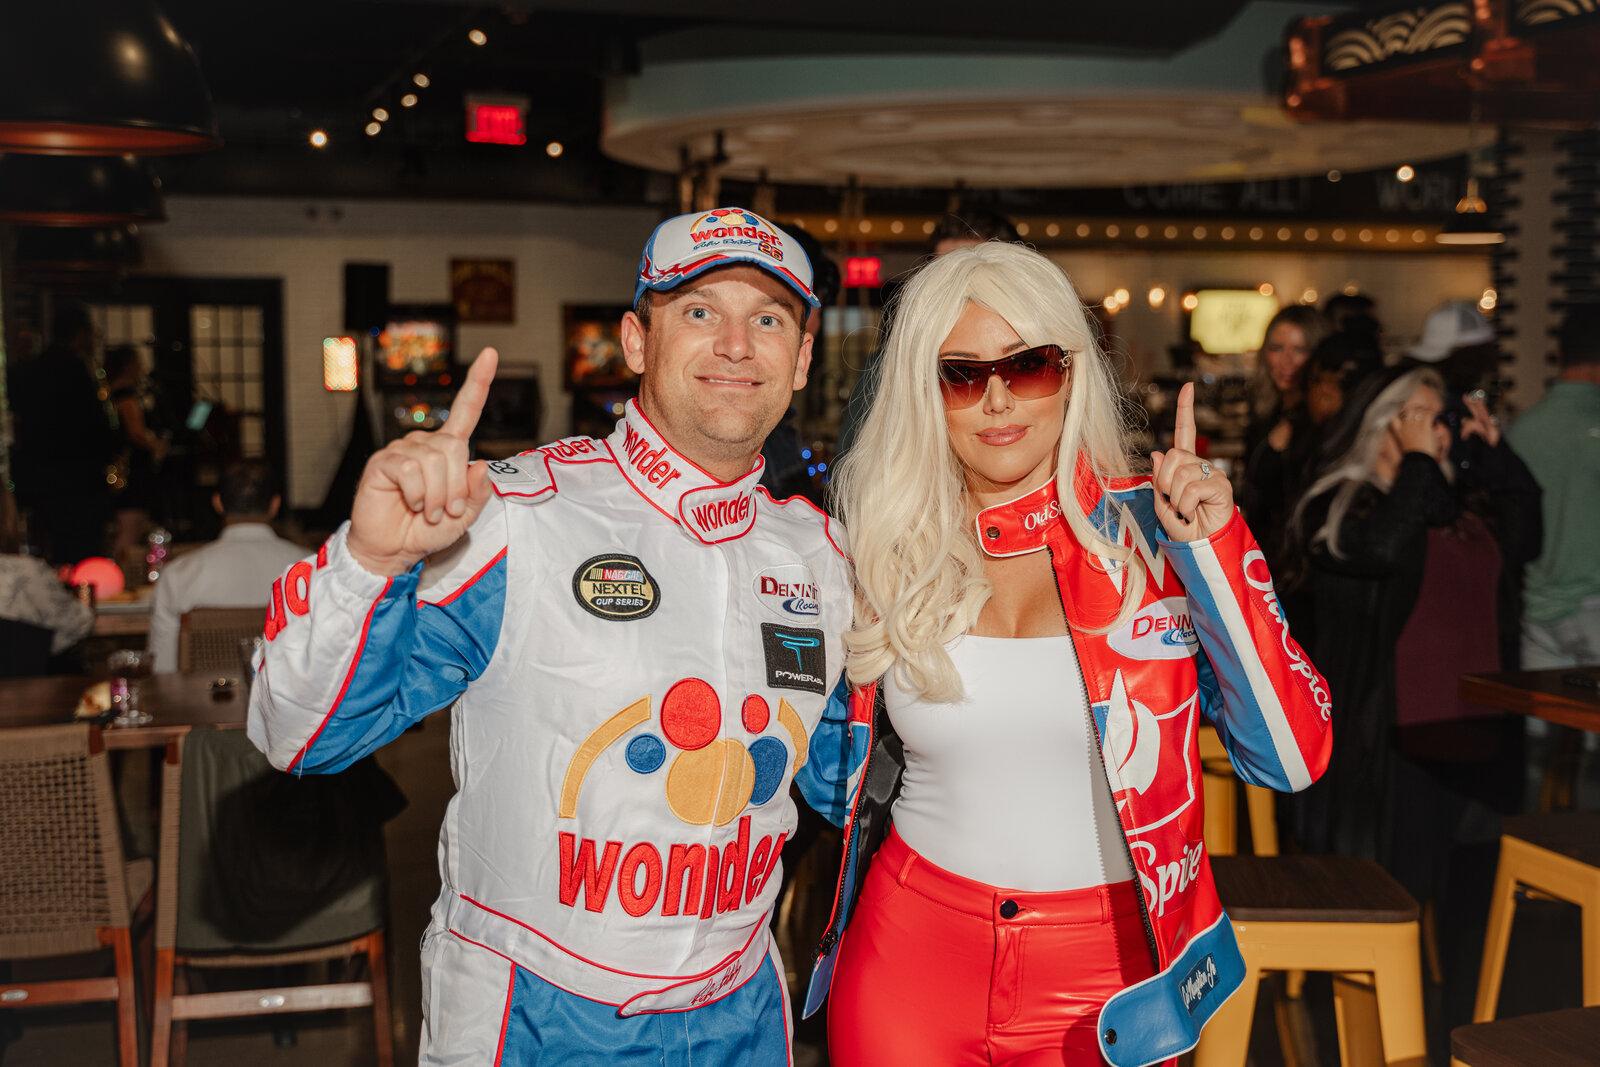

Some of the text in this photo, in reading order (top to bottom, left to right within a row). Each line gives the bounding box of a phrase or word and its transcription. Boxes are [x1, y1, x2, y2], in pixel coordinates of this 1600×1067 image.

[690, 226, 780, 246] wonder
[758, 241, 783, 262] 26
[535, 437, 598, 458] nder
[622, 420, 682, 490] wonder
[691, 490, 753, 533] wonder
[1024, 508, 1048, 531] Old
[592, 582, 646, 597] NEXTEL
[595, 598, 644, 607] CUP SERIES
[1131, 613, 1194, 640] DENN
[558, 815, 790, 920] wonder
[1129, 840, 1204, 917] Spice
